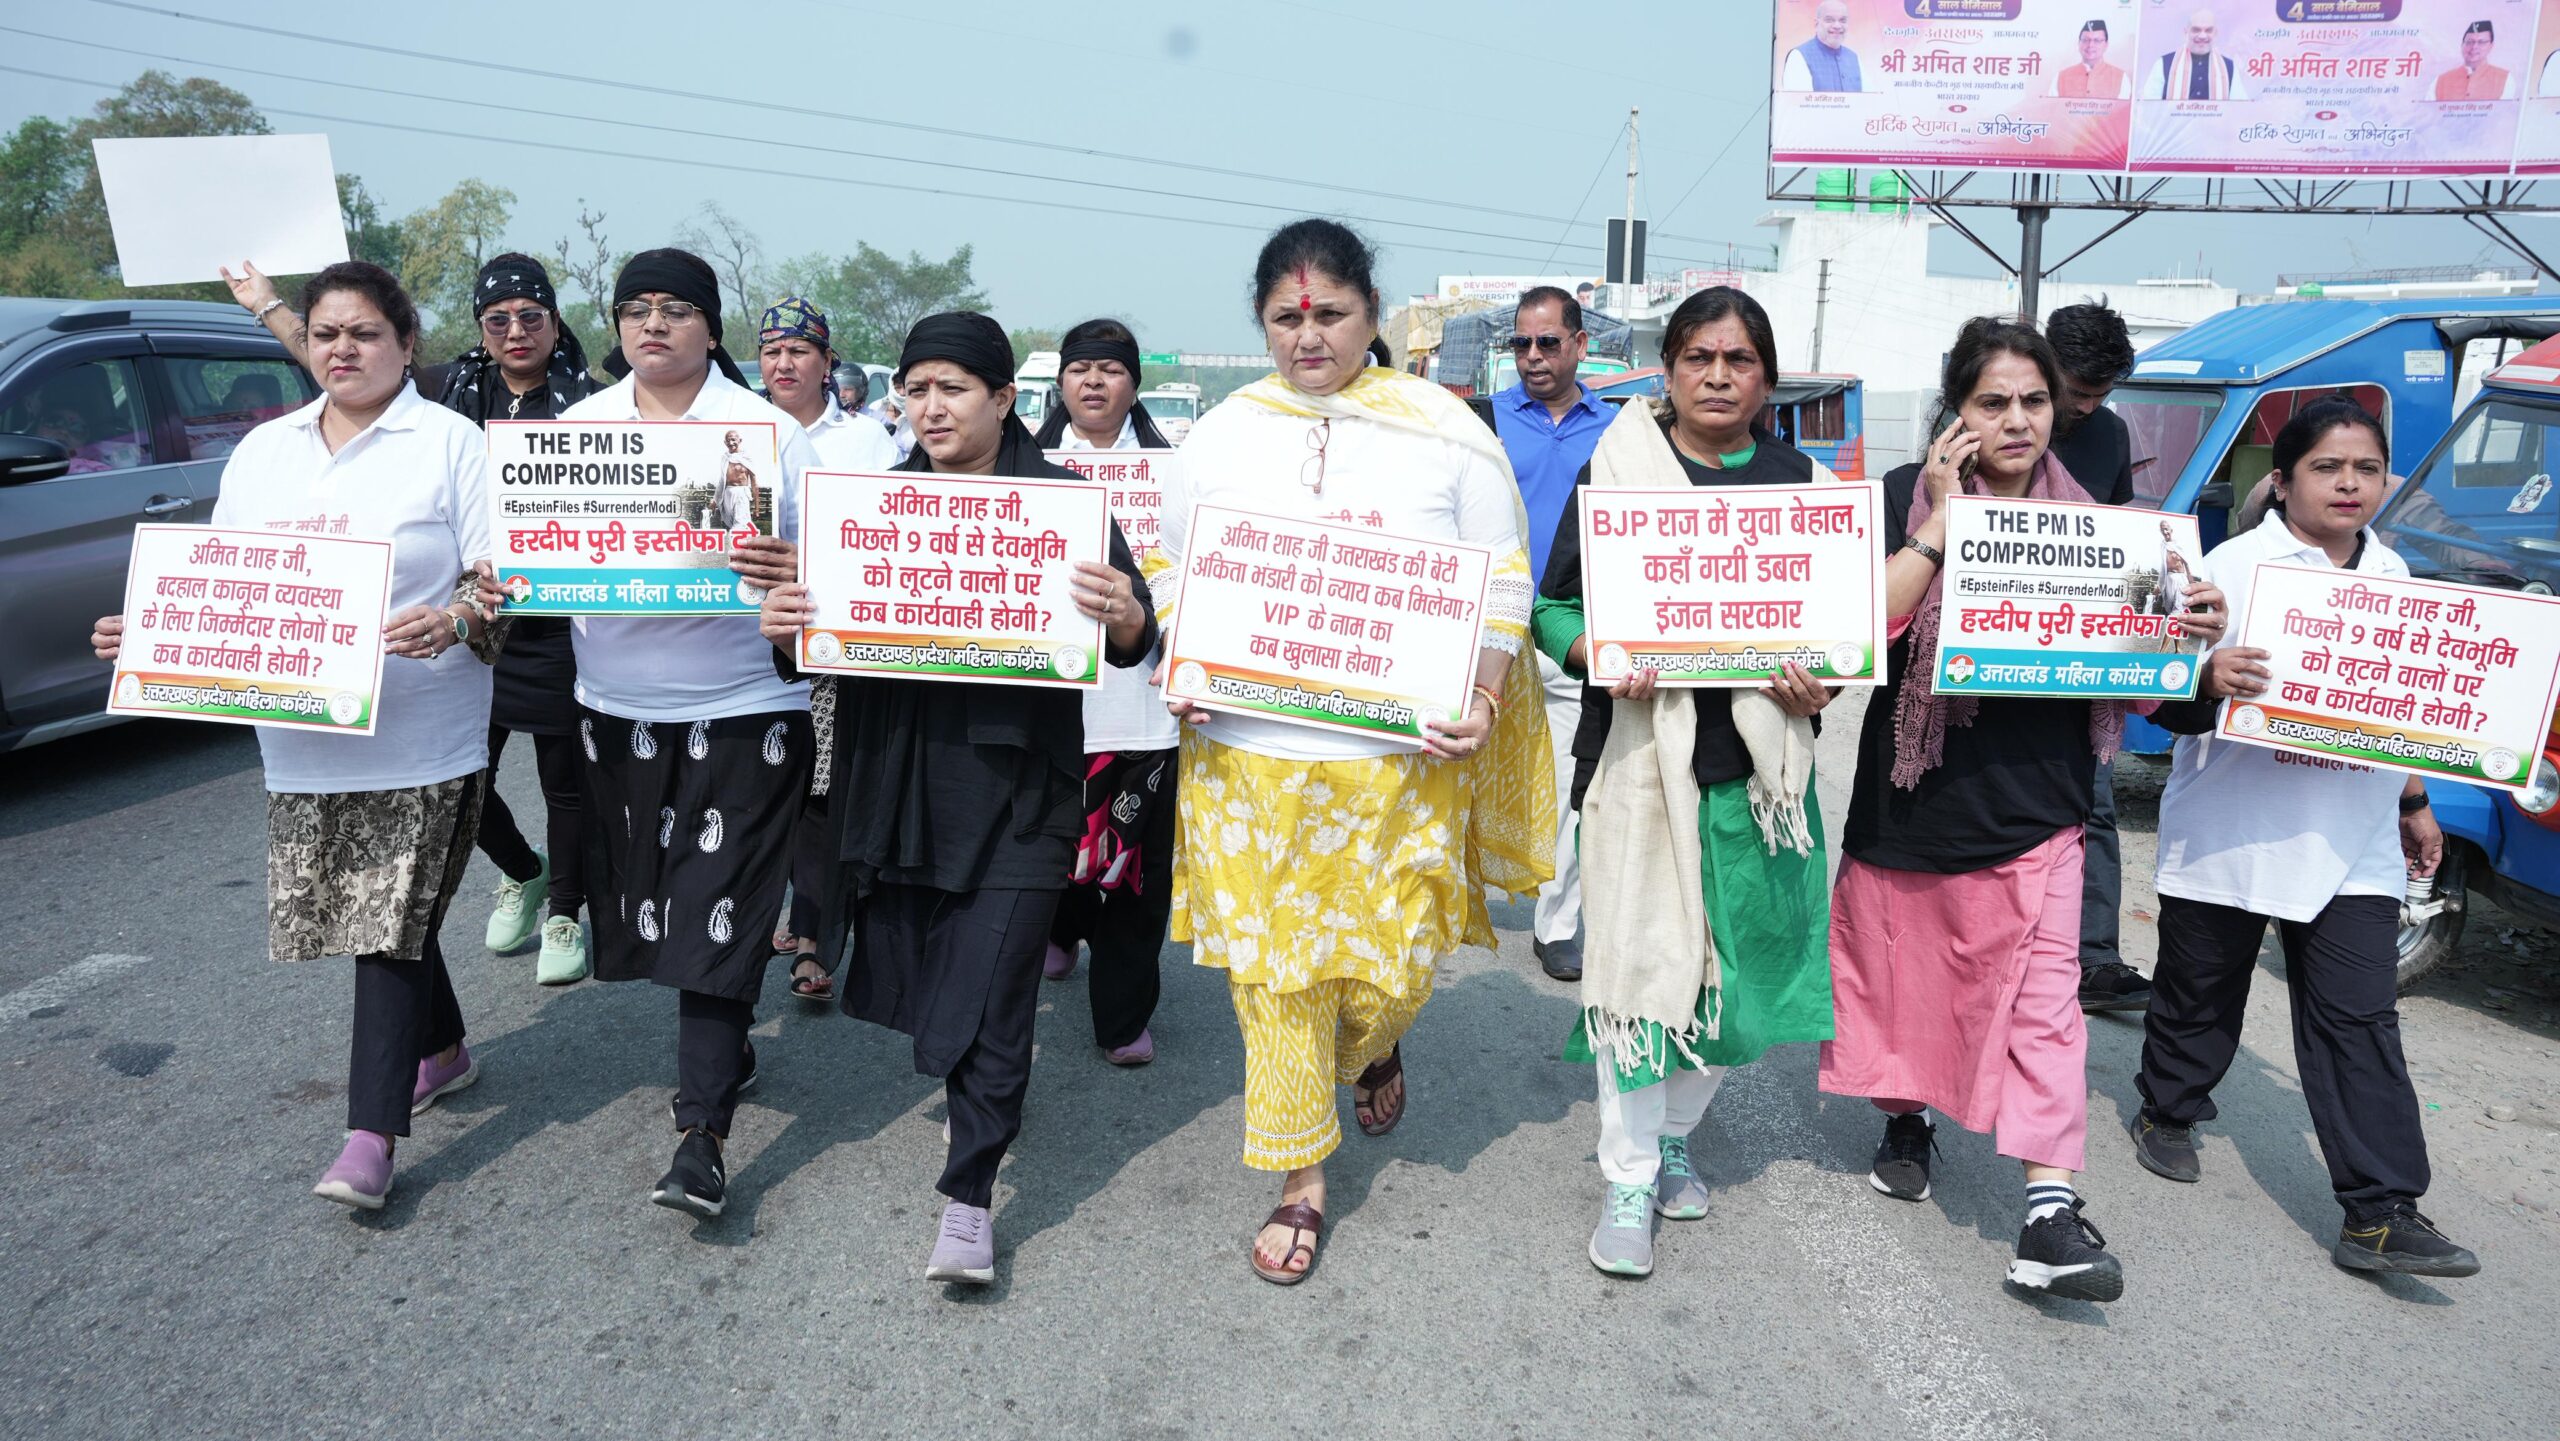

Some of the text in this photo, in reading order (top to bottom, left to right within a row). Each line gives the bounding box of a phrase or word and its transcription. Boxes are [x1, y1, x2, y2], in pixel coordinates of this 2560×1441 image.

[2288, 1, 2304, 21] 4
[1881, 49, 2042, 76] श्री अमित शाह जी
[2247, 51, 2422, 78] श्री अमित शाह जी
[1865, 114, 1907, 135] हार्दिक
[1912, 116, 1957, 136] स्वागत
[2239, 122, 2278, 142] हार्दिक
[2283, 125, 2325, 143] स्वागत
[524, 433, 644, 455] THE PM IS
[502, 463, 677, 485] COMPROMISED
[1099, 459, 1155, 484] शाह जी,
[505, 499, 676, 514] #EpsteinFiles #SurrenderModi
[879, 485, 1029, 527] अमित शाह जी,
[1593, 496, 1864, 546] BJP राज में युवा बेहाल,
[1985, 509, 2095, 537] THE PM IS
[190, 537, 312, 577] अमित शाह जी,
[509, 520, 724, 564] हरदीप पुरी इस्तीफा
[840, 519, 900, 552] पिछले
[929, 524, 960, 556] वर्ष
[965, 526, 986, 557] से
[992, 527, 1067, 568] देवभूमि
[1220, 521, 1458, 584] अमित शाह जी उत्तराखंड की बेटी
[1961, 540, 2125, 569] COMPROMISED
[863, 558, 1042, 598] को लूटने वालों पर
[1192, 550, 1247, 583] अंकिता
[1251, 562, 1298, 592] भंडारी
[1300, 566, 1324, 596] को
[1327, 577, 1370, 603] न्याय
[1374, 586, 1402, 610] कब
[1643, 545, 1812, 584] कहाँ गयी डबल
[156, 576, 343, 609] बदहाल कानून व्यवस्था
[537, 579, 731, 603] उत्तराखंड महिला कांग्रेस
[1960, 577, 2124, 598] #EpsteinFiles #SurrenderModi
[141, 602, 358, 646] के लिए जिम्मेदार लोगों पर
[850, 600, 886, 623] कब
[895, 598, 983, 630] कार्यवाही
[1263, 601, 1392, 643] VIP के नाम का
[1654, 596, 1803, 634] इंजन सरकार
[1960, 600, 2163, 646] हरदीप पुरी इस्तीफा
[2327, 582, 2481, 632] अमित शाह जी,
[153, 643, 183, 666] कब
[187, 640, 263, 673] कार्यवाही
[845, 641, 1049, 672] उत्तराखण्ड प्रदेश महिला कांग्रेस
[1250, 633, 1280, 659] कब
[1283, 638, 1342, 670] खुलासा
[2283, 608, 2345, 643] पिछले
[2373, 623, 2407, 655] वर्ष
[2410, 630, 2433, 656] से
[2436, 630, 2519, 672] देवभूमि
[1696, 648, 1729, 673] प्रदेश
[1730, 647, 1777, 672] महिला
[1979, 656, 2157, 686] उत्तराखंड महिला कांग्रेस
[2301, 646, 2485, 698] को लूटने वालों पर
[142, 683, 326, 716] उत्तराखण्ड प्रदेश महिला कांग्रेस
[1210, 674, 1412, 726] उत्तराखण्ड प्रदेश महिला कांग्रेस
[2282, 681, 2320, 706] कब
[2325, 687, 2417, 722] कार्यवाही
[2268, 717, 2478, 769] उत्तराखण्ड प्रदेश महिला कांग्रेस
